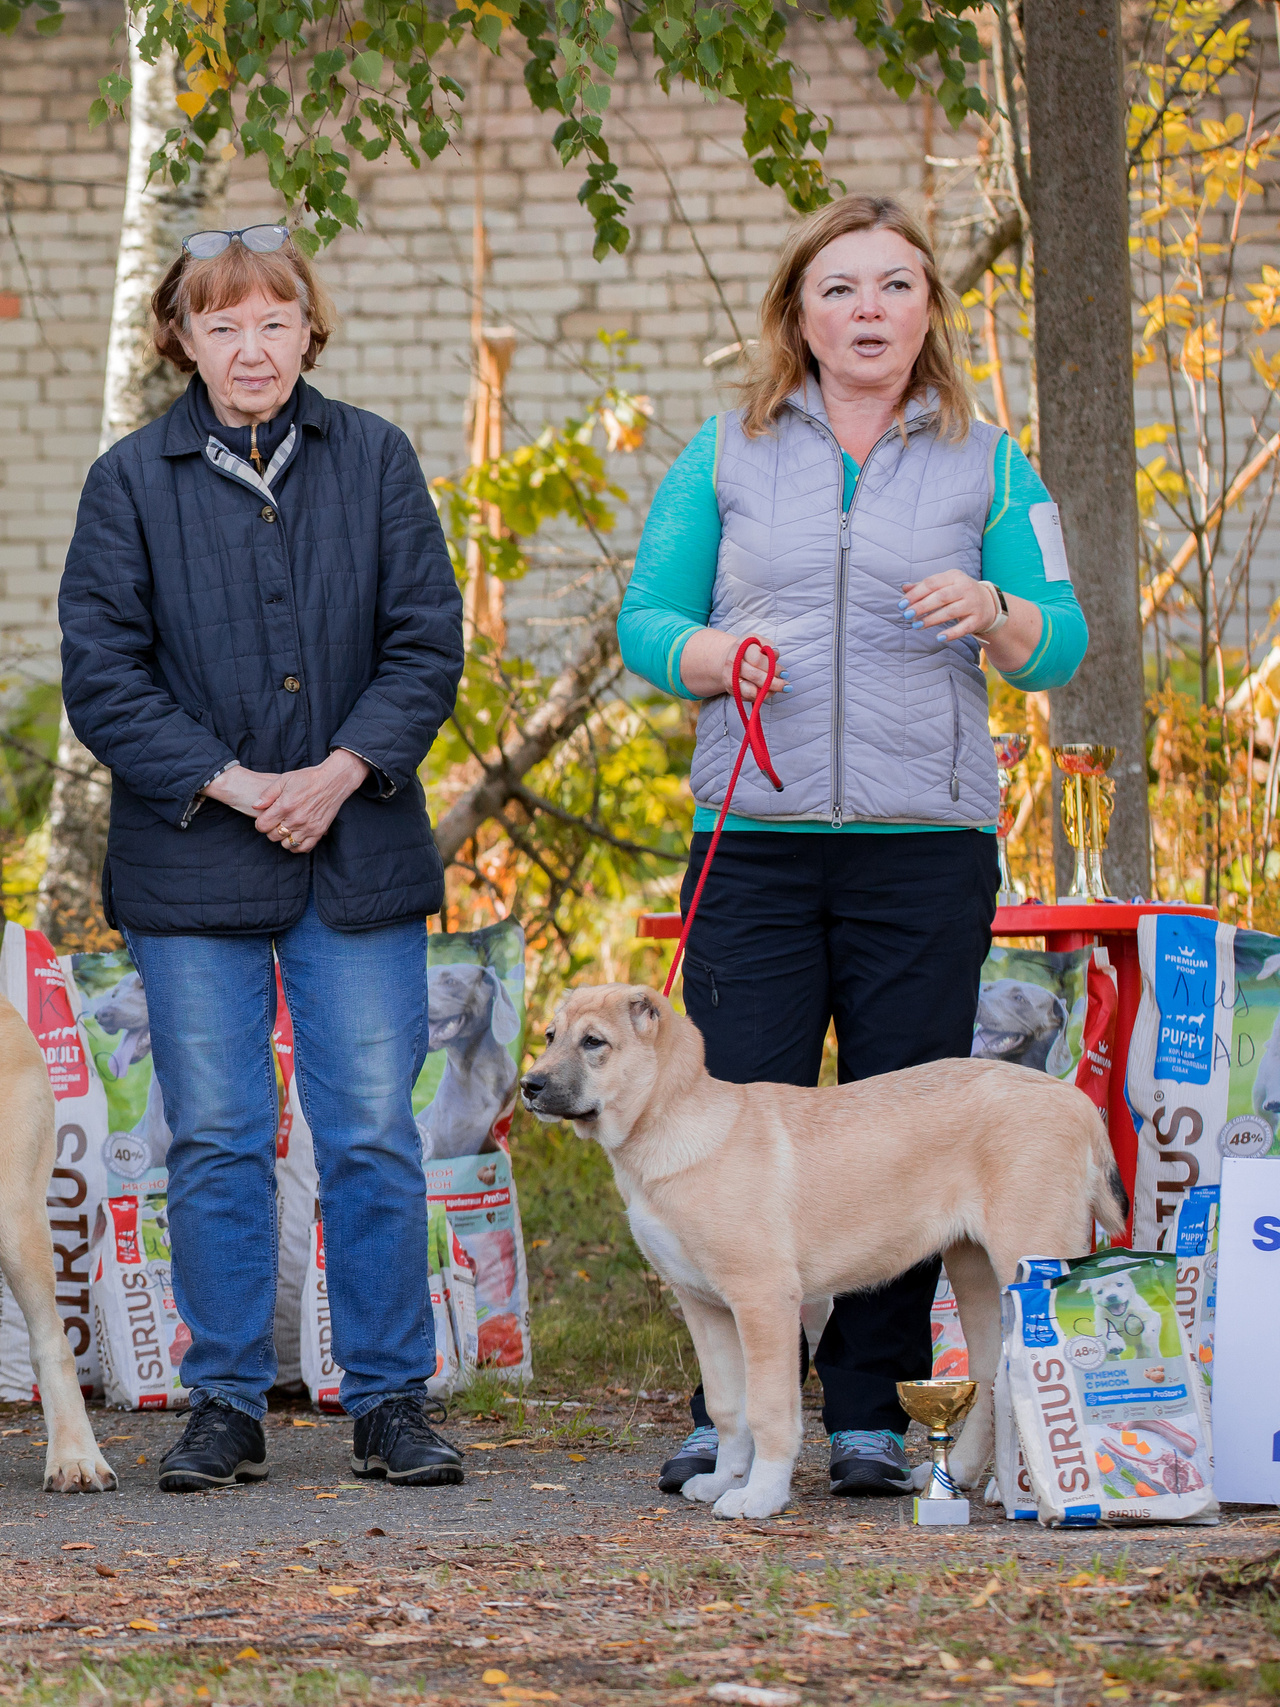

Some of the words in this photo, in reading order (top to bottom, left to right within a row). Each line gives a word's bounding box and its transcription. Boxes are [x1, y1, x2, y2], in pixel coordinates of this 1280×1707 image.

[1164, 954, 1209, 969] PREMIUM
[34, 967, 65, 980] PREMI
[1176, 965, 1196, 975] FOOD
[1161, 1027, 1206, 1051] PUPPY
[1171, 1065, 1189, 1074] СОБАК
[1229, 1131, 1263, 1146] 48%
[114, 1148, 144, 1162] 40%
[121, 1179, 169, 1192] МЯСНО
[1180, 1232, 1205, 1242] PUPPY
[122, 1272, 164, 1381] SIRIUS
[1074, 1346, 1099, 1358] 48%
[1083, 1368, 1128, 1381] ЯГНЕНОК
[1086, 1381, 1093, 1390] С
[1095, 1378, 1130, 1389] РИСОМ
[1152, 1389, 1183, 1399] ProStor+
[1032, 1357, 1090, 1494] SIRIUS
[1107, 1508, 1151, 1519] SIRIUS
